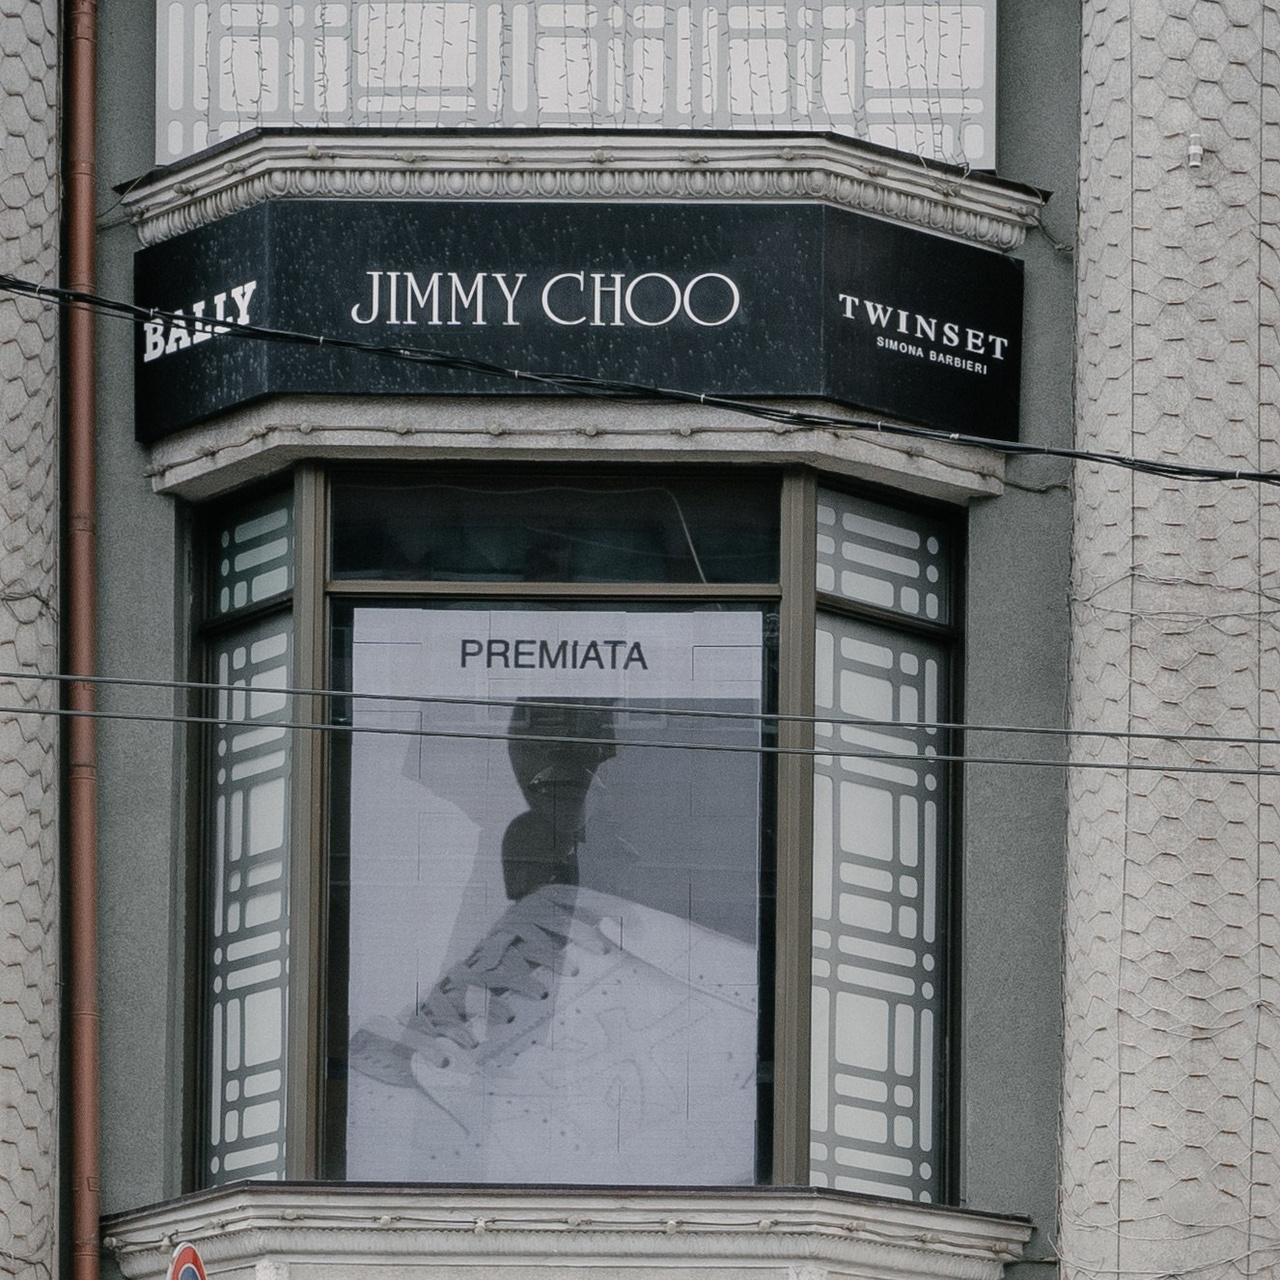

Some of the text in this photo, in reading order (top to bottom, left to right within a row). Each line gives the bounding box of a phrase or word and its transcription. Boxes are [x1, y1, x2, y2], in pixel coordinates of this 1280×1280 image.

[144, 280, 257, 362] BALLY
[352, 270, 740, 326] JIMMY CHOO
[838, 293, 1008, 360] TWINSET
[876, 336, 988, 375] SIMONA BARBIERI
[460, 639, 649, 670] PREMIATA
